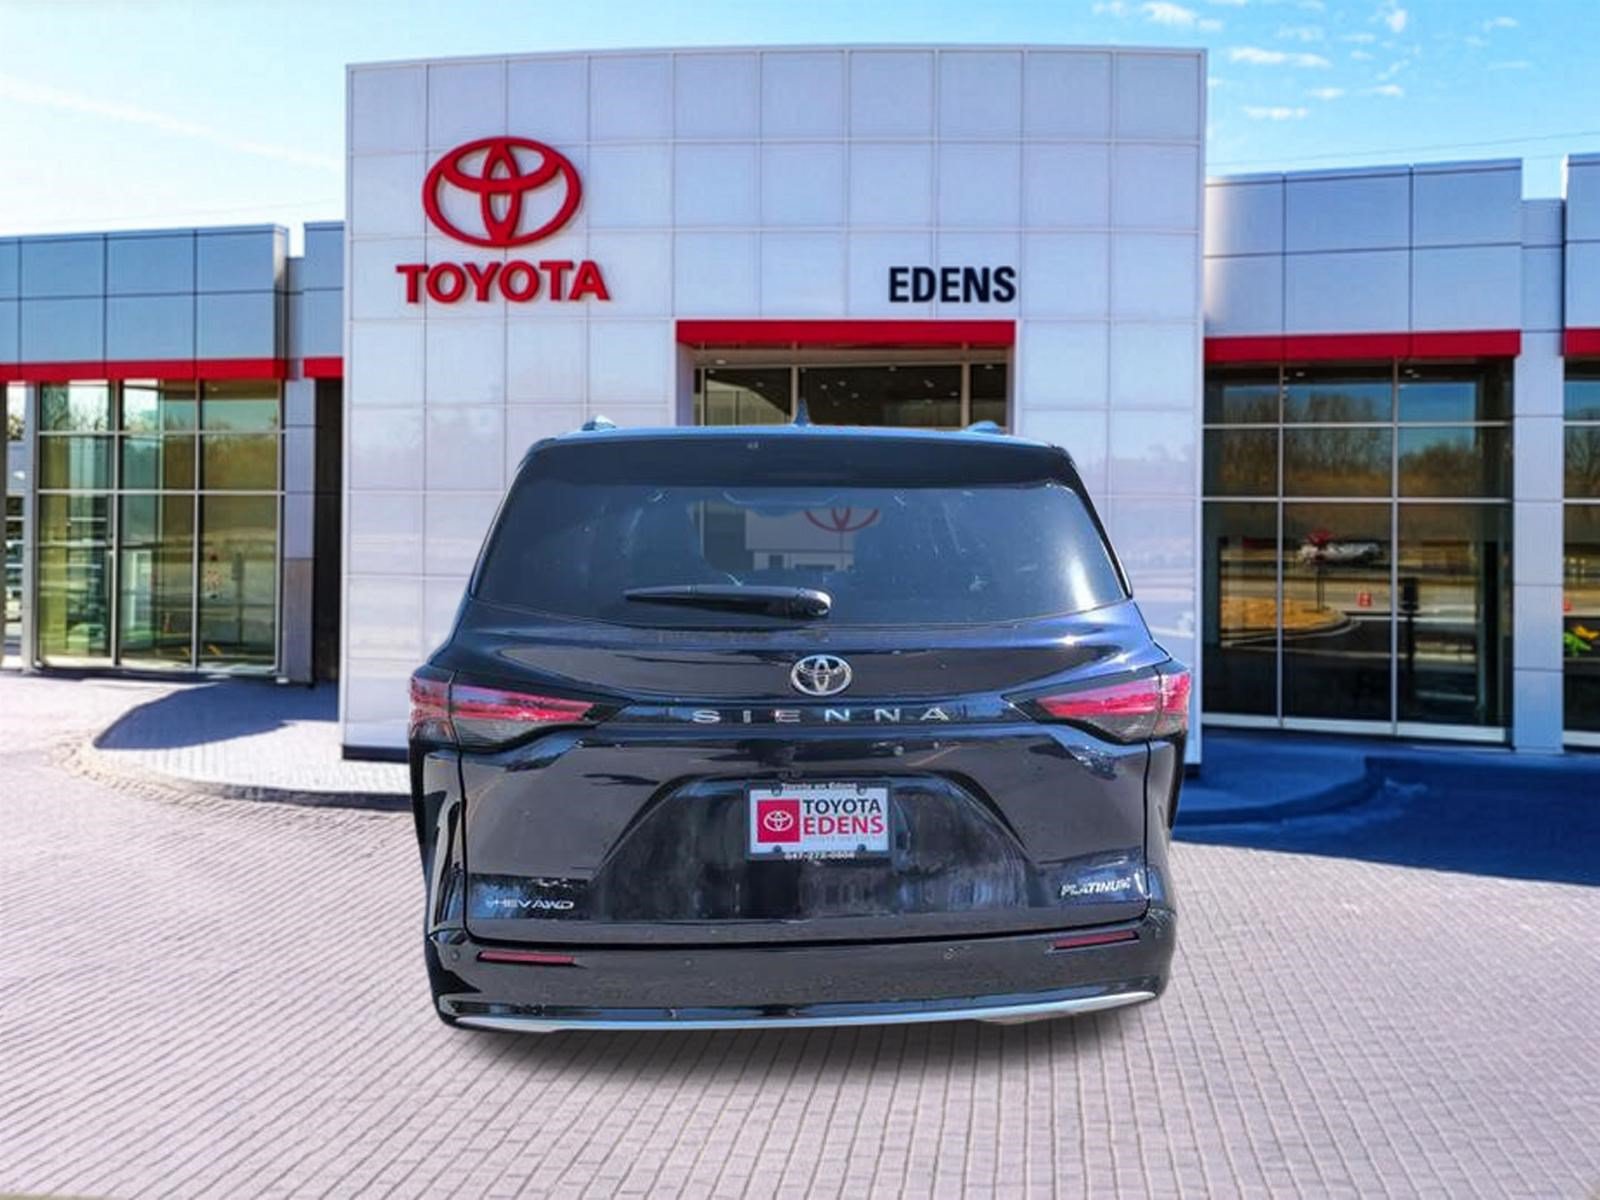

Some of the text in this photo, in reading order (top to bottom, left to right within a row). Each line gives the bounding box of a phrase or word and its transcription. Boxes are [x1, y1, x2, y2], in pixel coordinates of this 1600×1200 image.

[397, 260, 611, 304] TOYOTA
[888, 266, 1016, 303] EDENS
[692, 707, 949, 723] SIENNA
[803, 799, 881, 814] TOYOTA
[803, 816, 883, 835] EDENS
